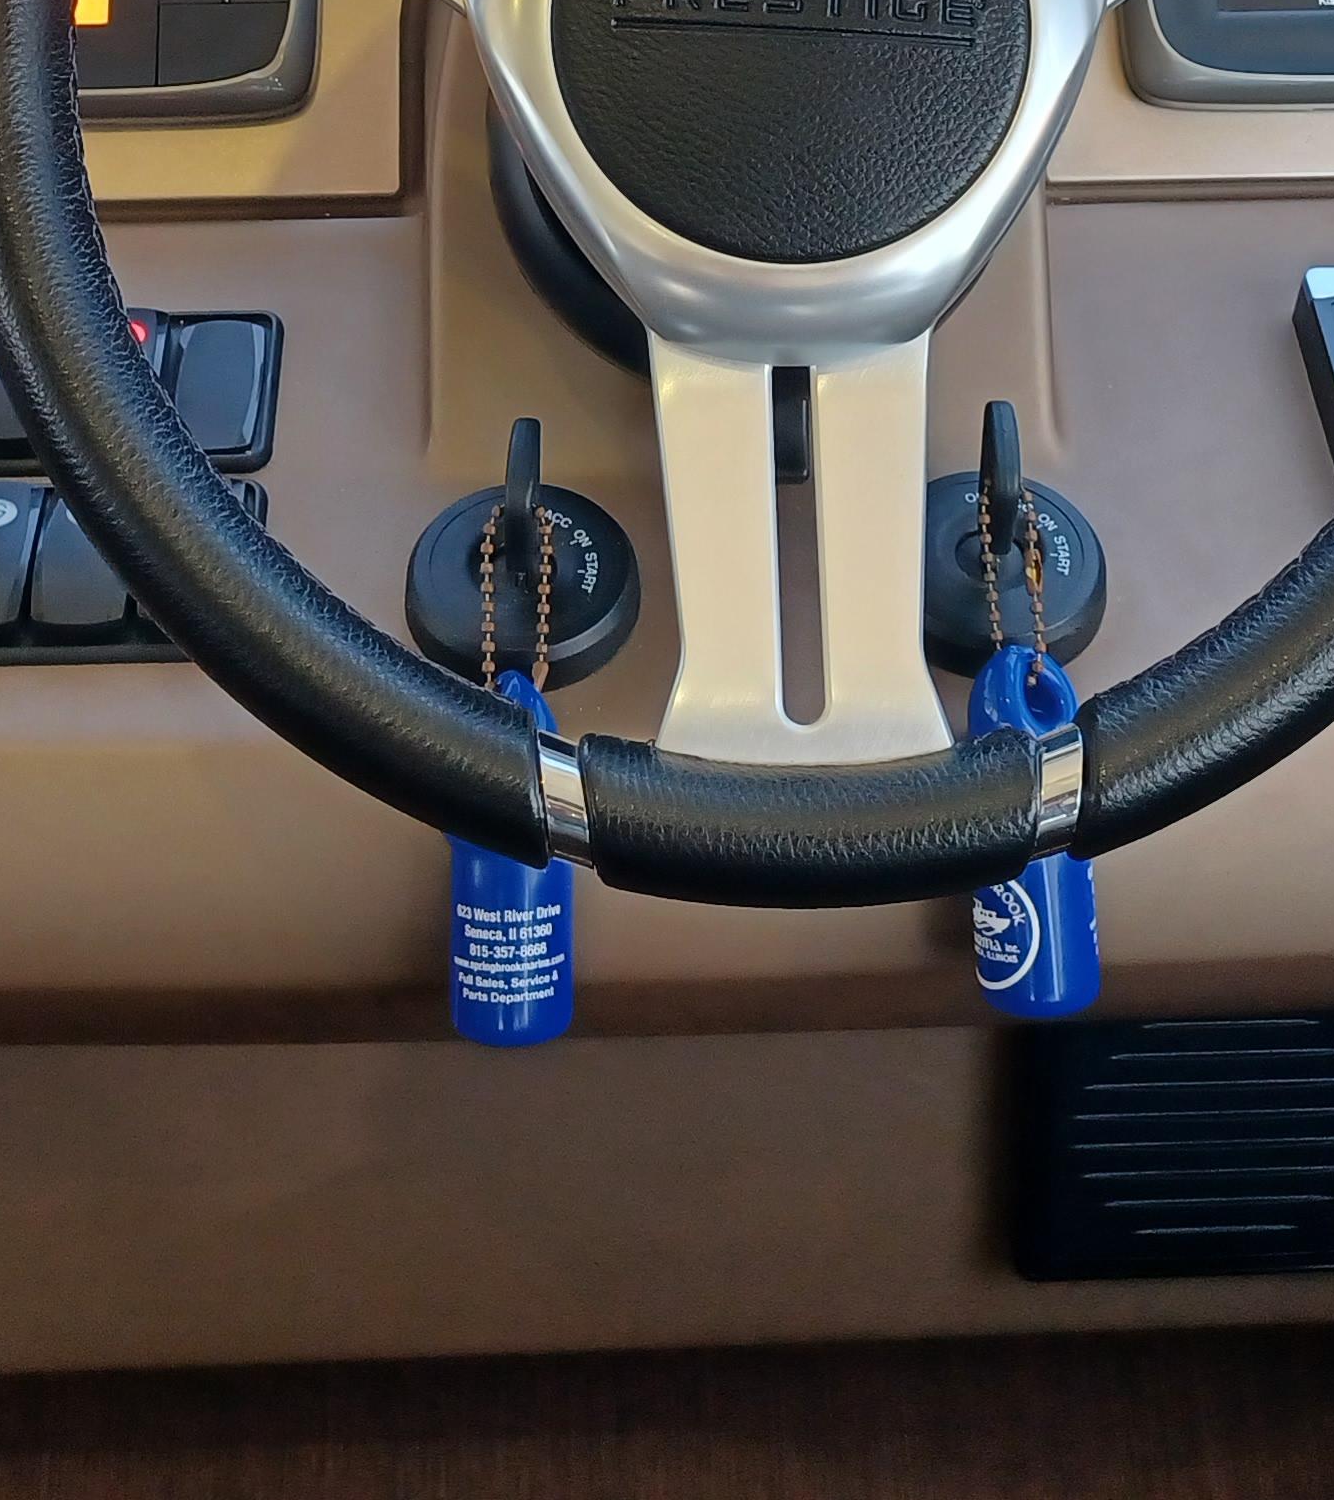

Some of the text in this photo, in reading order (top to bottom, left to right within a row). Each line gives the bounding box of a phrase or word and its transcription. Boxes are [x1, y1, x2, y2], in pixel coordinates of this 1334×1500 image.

[543, 508, 599, 594] ACC ON START
[1037, 512, 1071, 576] ON START
[473, 907, 501, 923] West
[504, 907, 534, 923] River
[536, 903, 561, 919] Drive
[464, 923, 507, 942] Seneca,
[510, 972, 551, 989] Service
[462, 985, 555, 1005] Parts Department
